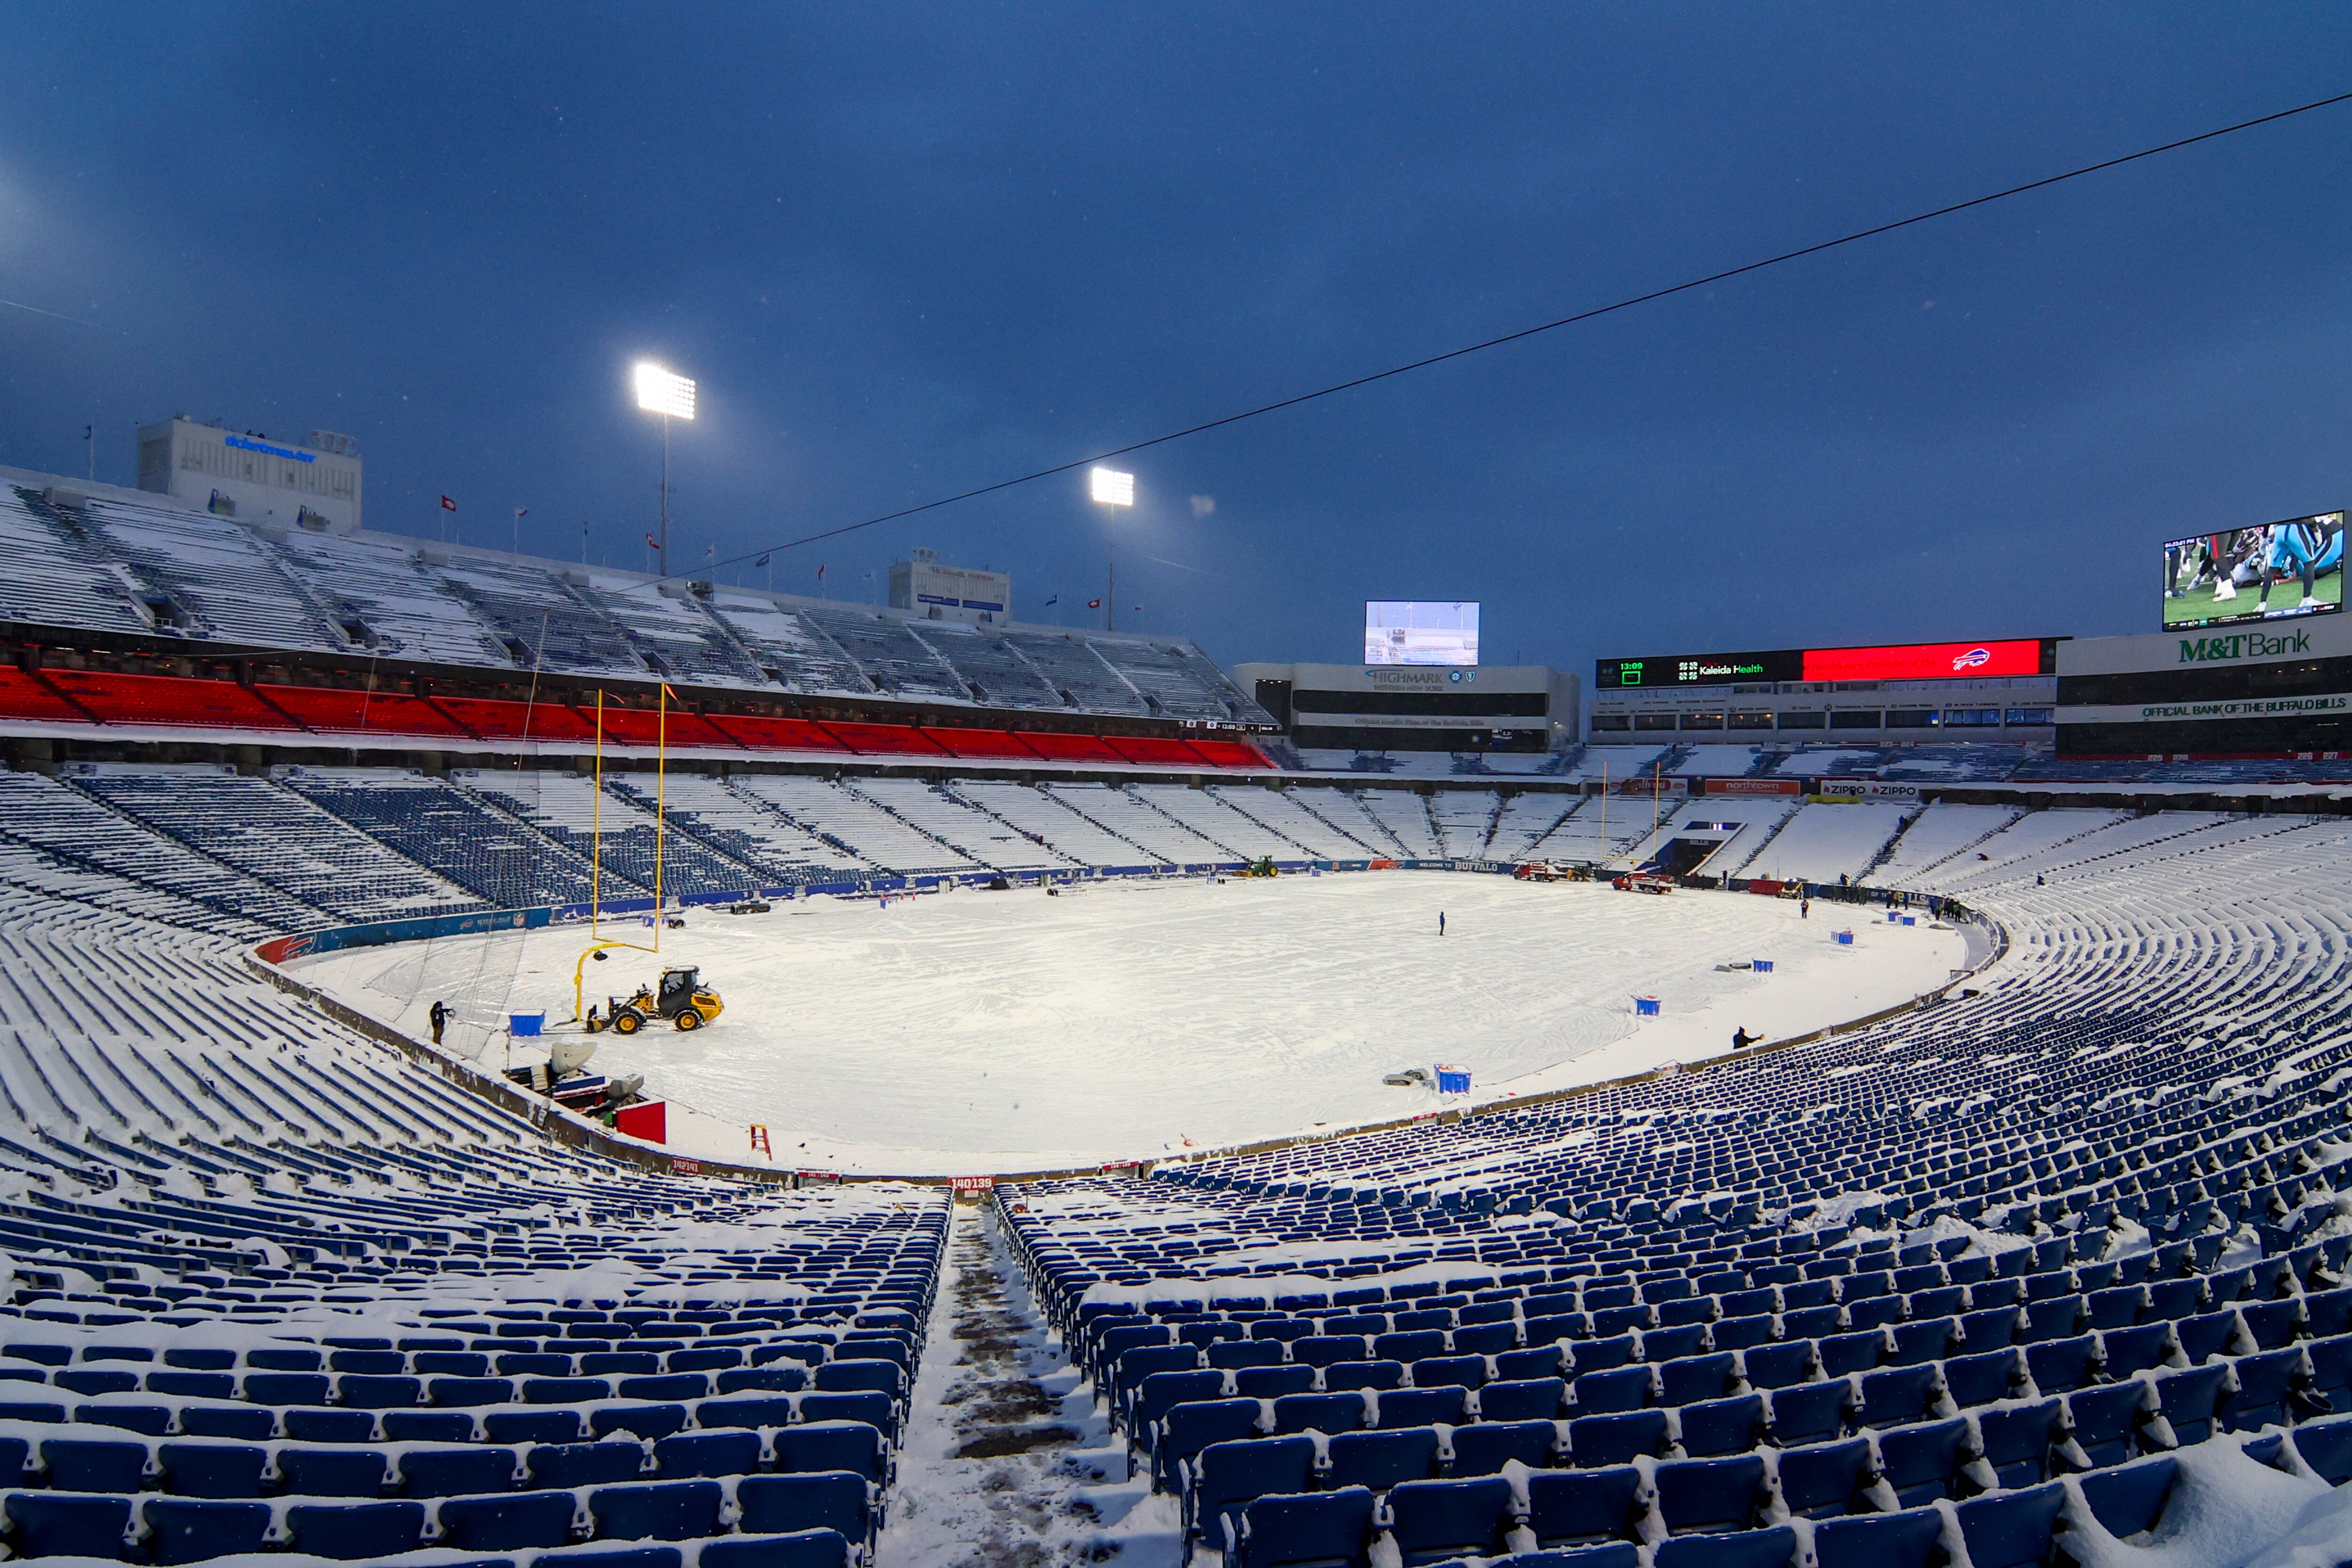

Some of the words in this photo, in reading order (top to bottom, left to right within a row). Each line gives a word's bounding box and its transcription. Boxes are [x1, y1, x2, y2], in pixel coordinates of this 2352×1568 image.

[2178, 634, 2247, 662] M&T
[2248, 629, 2311, 657] Bank
[1866, 660, 1906, 669] Provider
[1909, 658, 1919, 667] of
[1700, 665, 1731, 676] Kaleida
[1733, 664, 1764, 674] Health
[1374, 672, 1443, 683] HIGHMARK
[2143, 706, 2190, 717] OFFICIAL
[2193, 705, 2223, 716] BANK
[2225, 704, 2241, 714] OF
[2242, 703, 2265, 713] THE
[2266, 700, 2314, 711] BUFFALO
[2315, 697, 2347, 709] BILLS
[1725, 781, 1779, 789] northtown
[1880, 786, 1916, 795] ZIPPO
[1454, 862, 1498, 871] BUFFALO
[952, 1177, 992, 1190] 140/139
